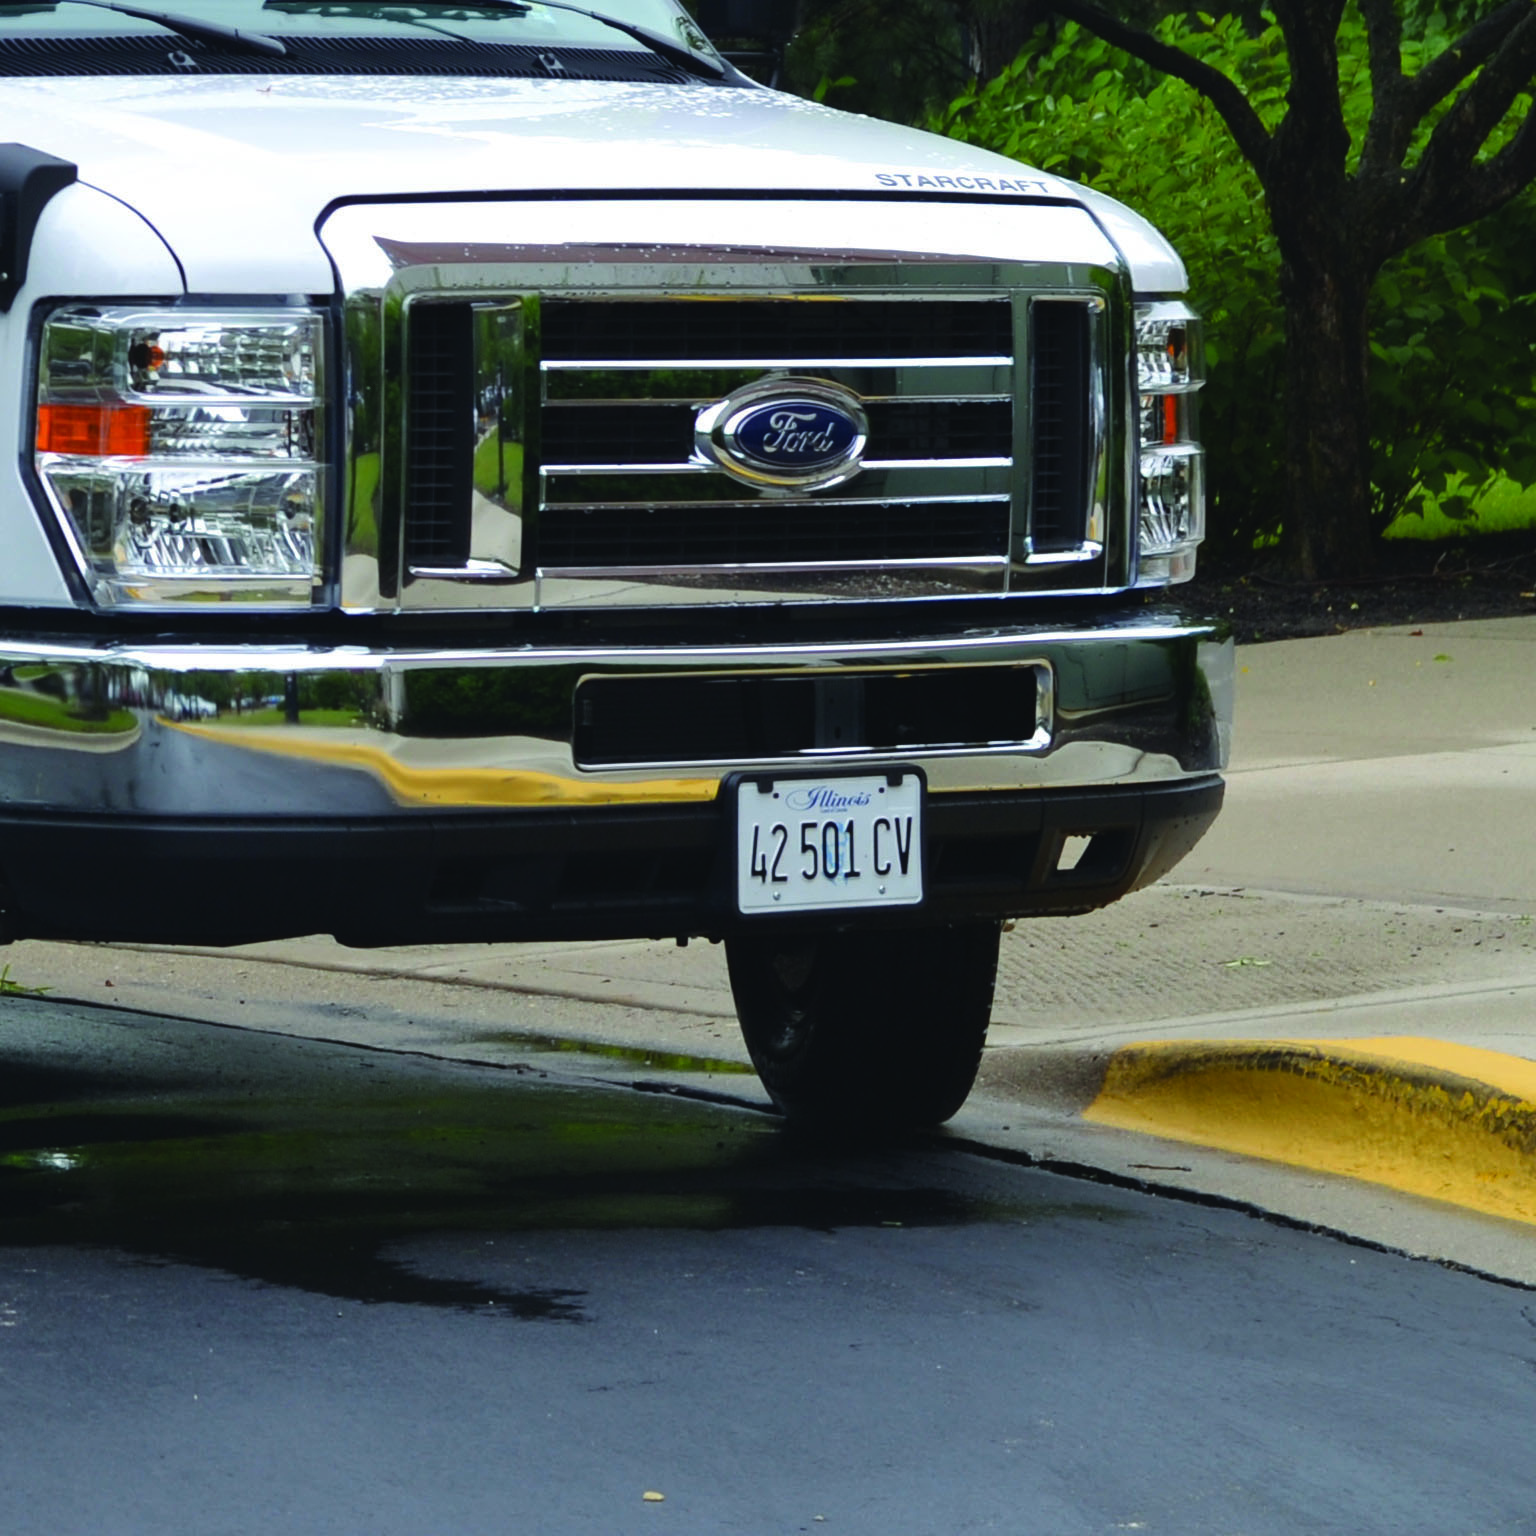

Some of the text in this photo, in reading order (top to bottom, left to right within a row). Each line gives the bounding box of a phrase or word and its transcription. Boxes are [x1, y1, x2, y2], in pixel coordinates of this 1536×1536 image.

[874, 173, 1049, 193] STARCRAFT
[763, 411, 834, 453] Ford
[786, 785, 872, 811] Illinois
[751, 816, 912, 884] 42 501 CV
